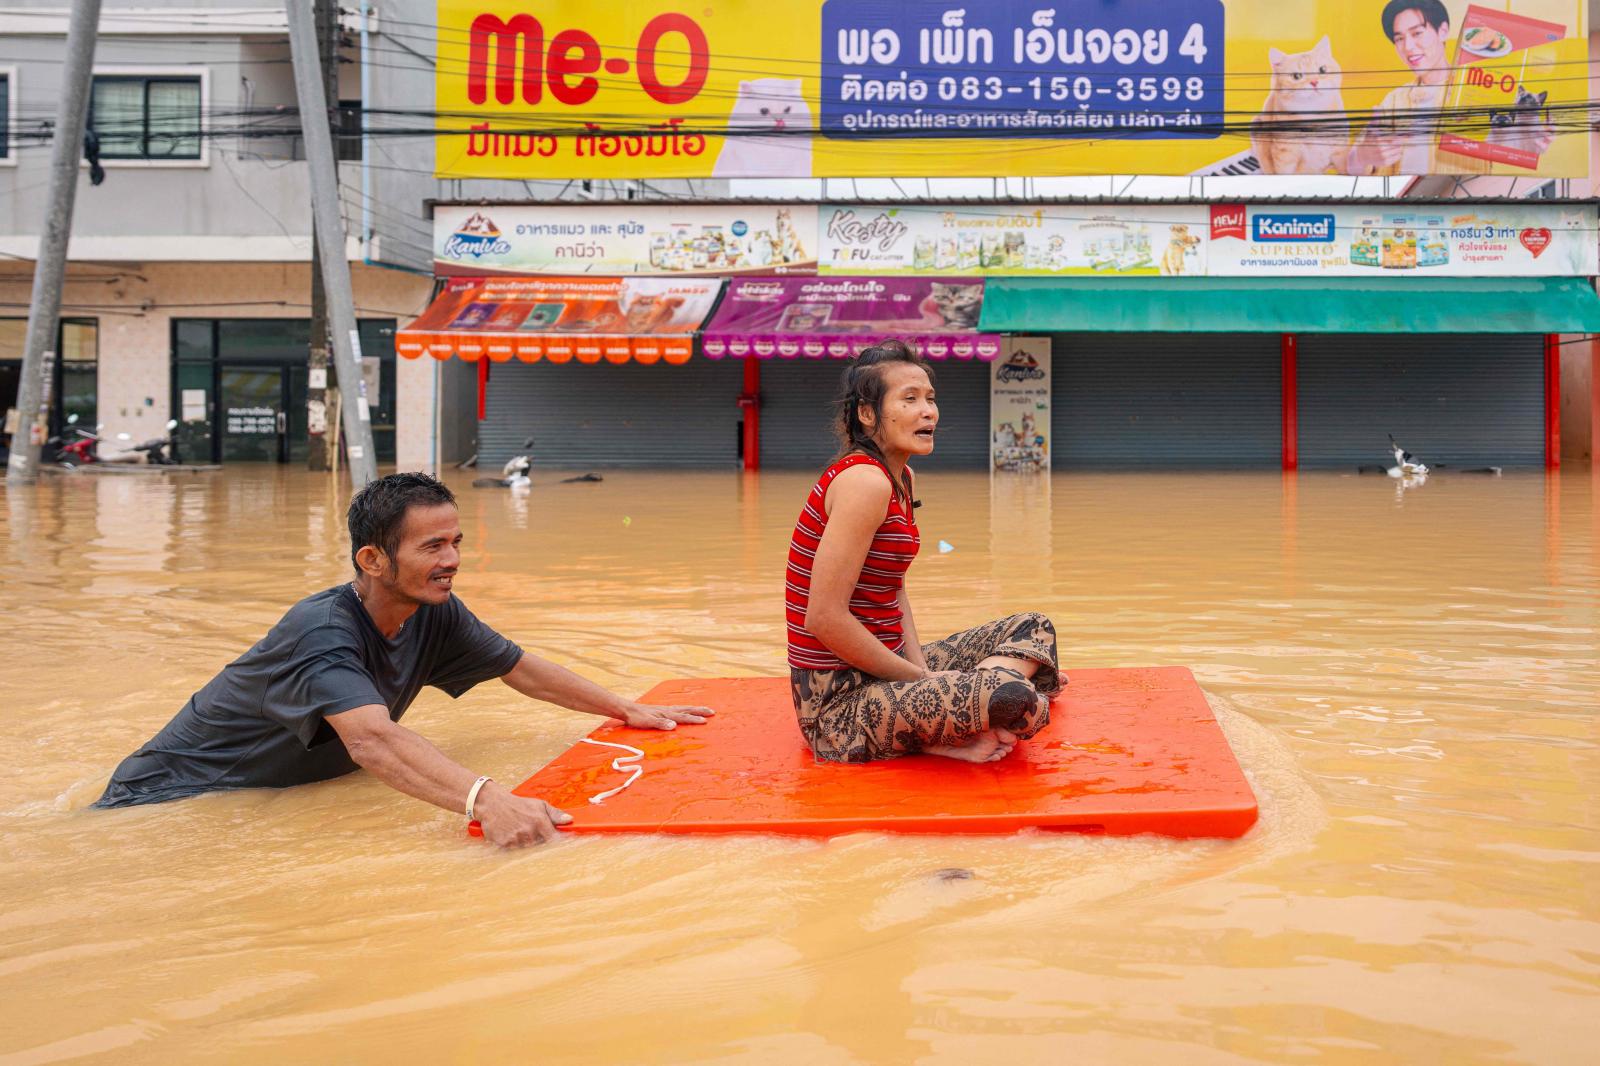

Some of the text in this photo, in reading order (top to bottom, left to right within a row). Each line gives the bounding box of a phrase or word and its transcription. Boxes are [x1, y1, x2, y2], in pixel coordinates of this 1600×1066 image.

[838, 8, 1208, 65] พอ เพ็ท เอ็นจอย 4
[840, 71, 1205, 102] ติดต่อ 083-150-3598
[516, 221, 646, 239] อาหารแมว และ สุนัข
[828, 208, 908, 250] Kasty
[1259, 218, 1329, 235] Kanimal
[1485, 226, 1495, 239] 3
[555, 242, 605, 259] คานิว่า
[1249, 244, 1335, 256] SUPREMO
